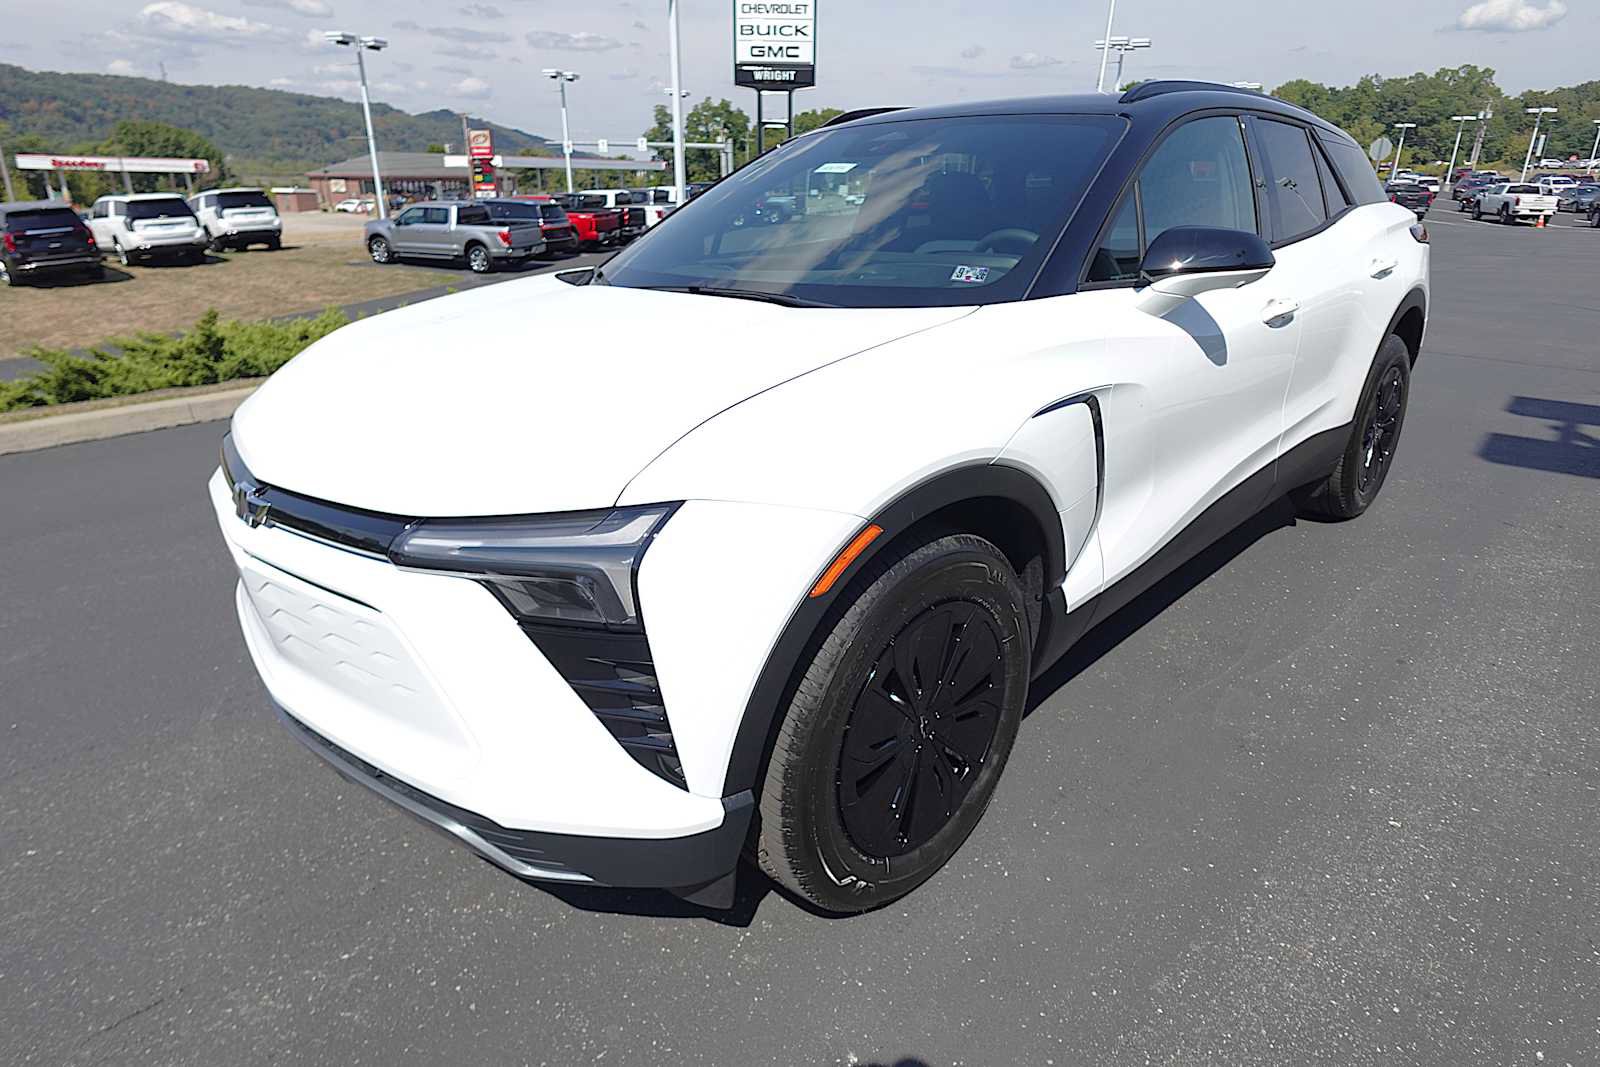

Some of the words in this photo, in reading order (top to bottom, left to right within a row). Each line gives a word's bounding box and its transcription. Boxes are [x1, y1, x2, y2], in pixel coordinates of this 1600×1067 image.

[741, 3, 808, 14] CHEVROLET
[740, 24, 808, 36] BUICK
[750, 46, 800, 58] GMC
[752, 70, 796, 81] WRIGHT
